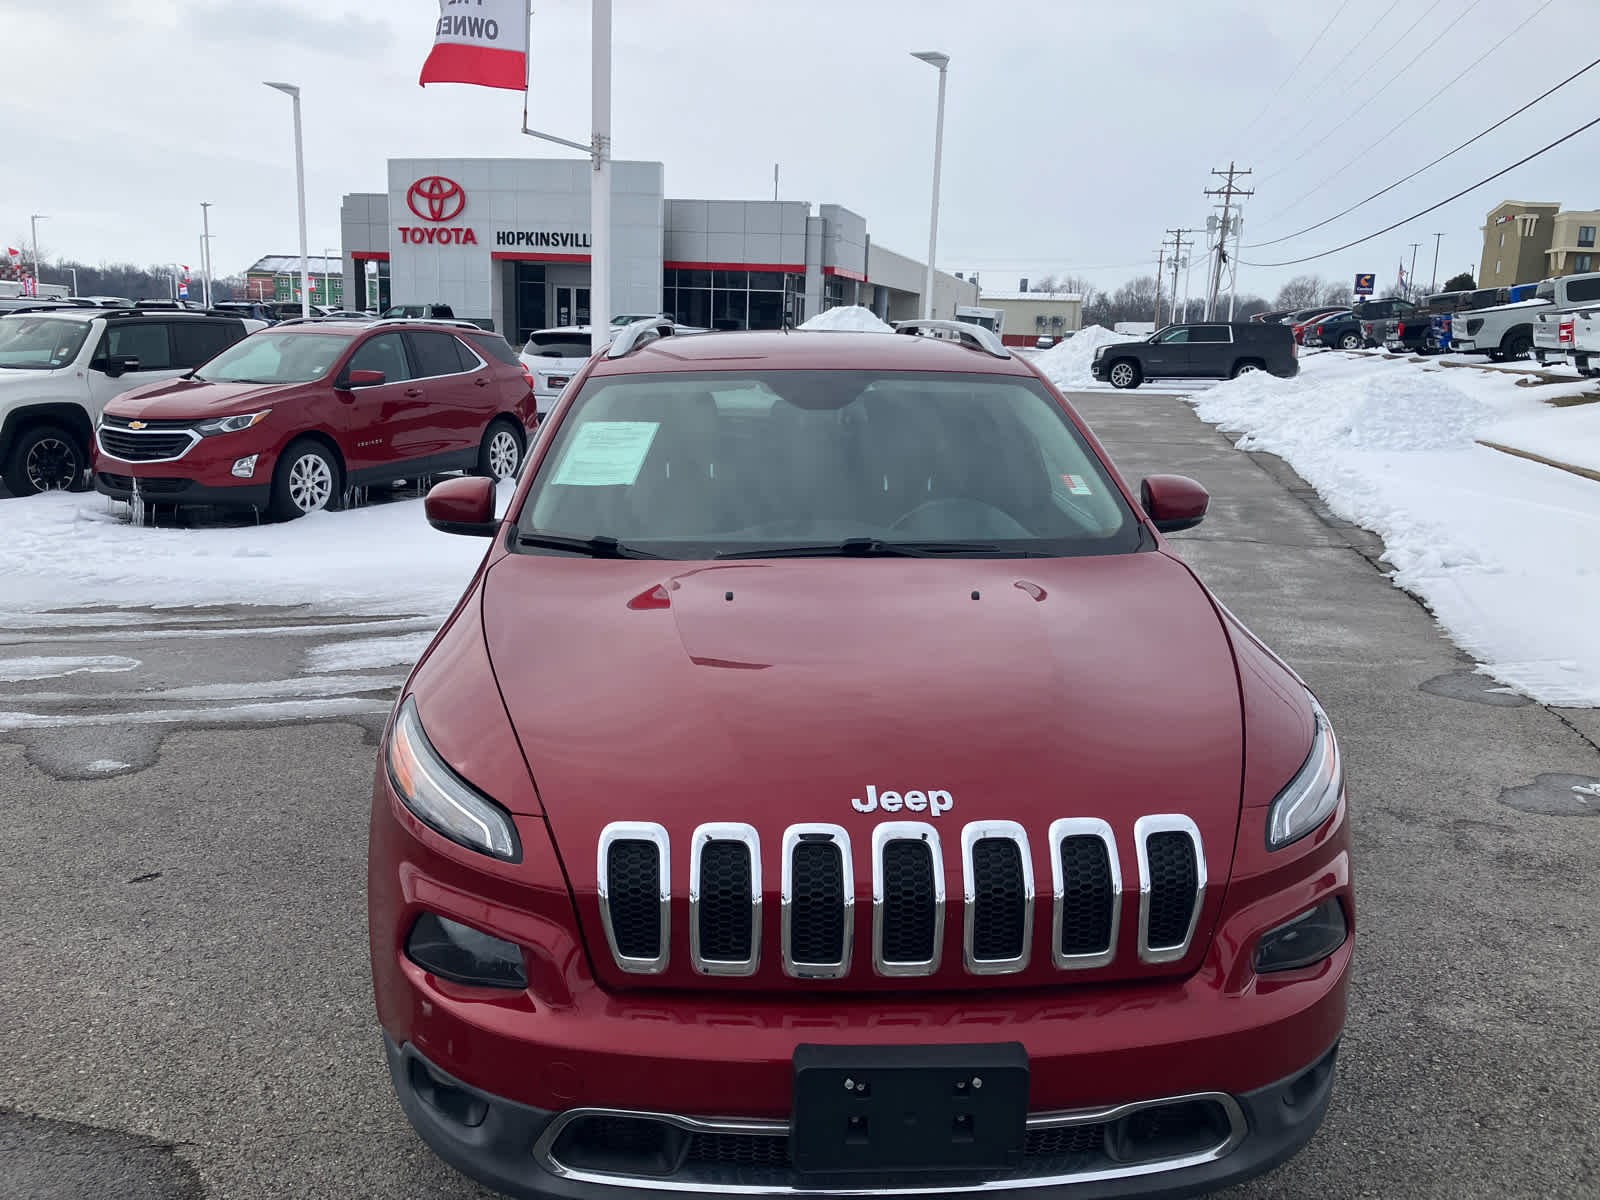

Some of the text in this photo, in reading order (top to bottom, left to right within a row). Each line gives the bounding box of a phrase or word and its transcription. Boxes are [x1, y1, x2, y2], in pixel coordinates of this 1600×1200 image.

[398, 227, 477, 245] TOYOTA
[496, 231, 592, 248] HOPKINSVILL
[851, 784, 954, 817] Jeep
